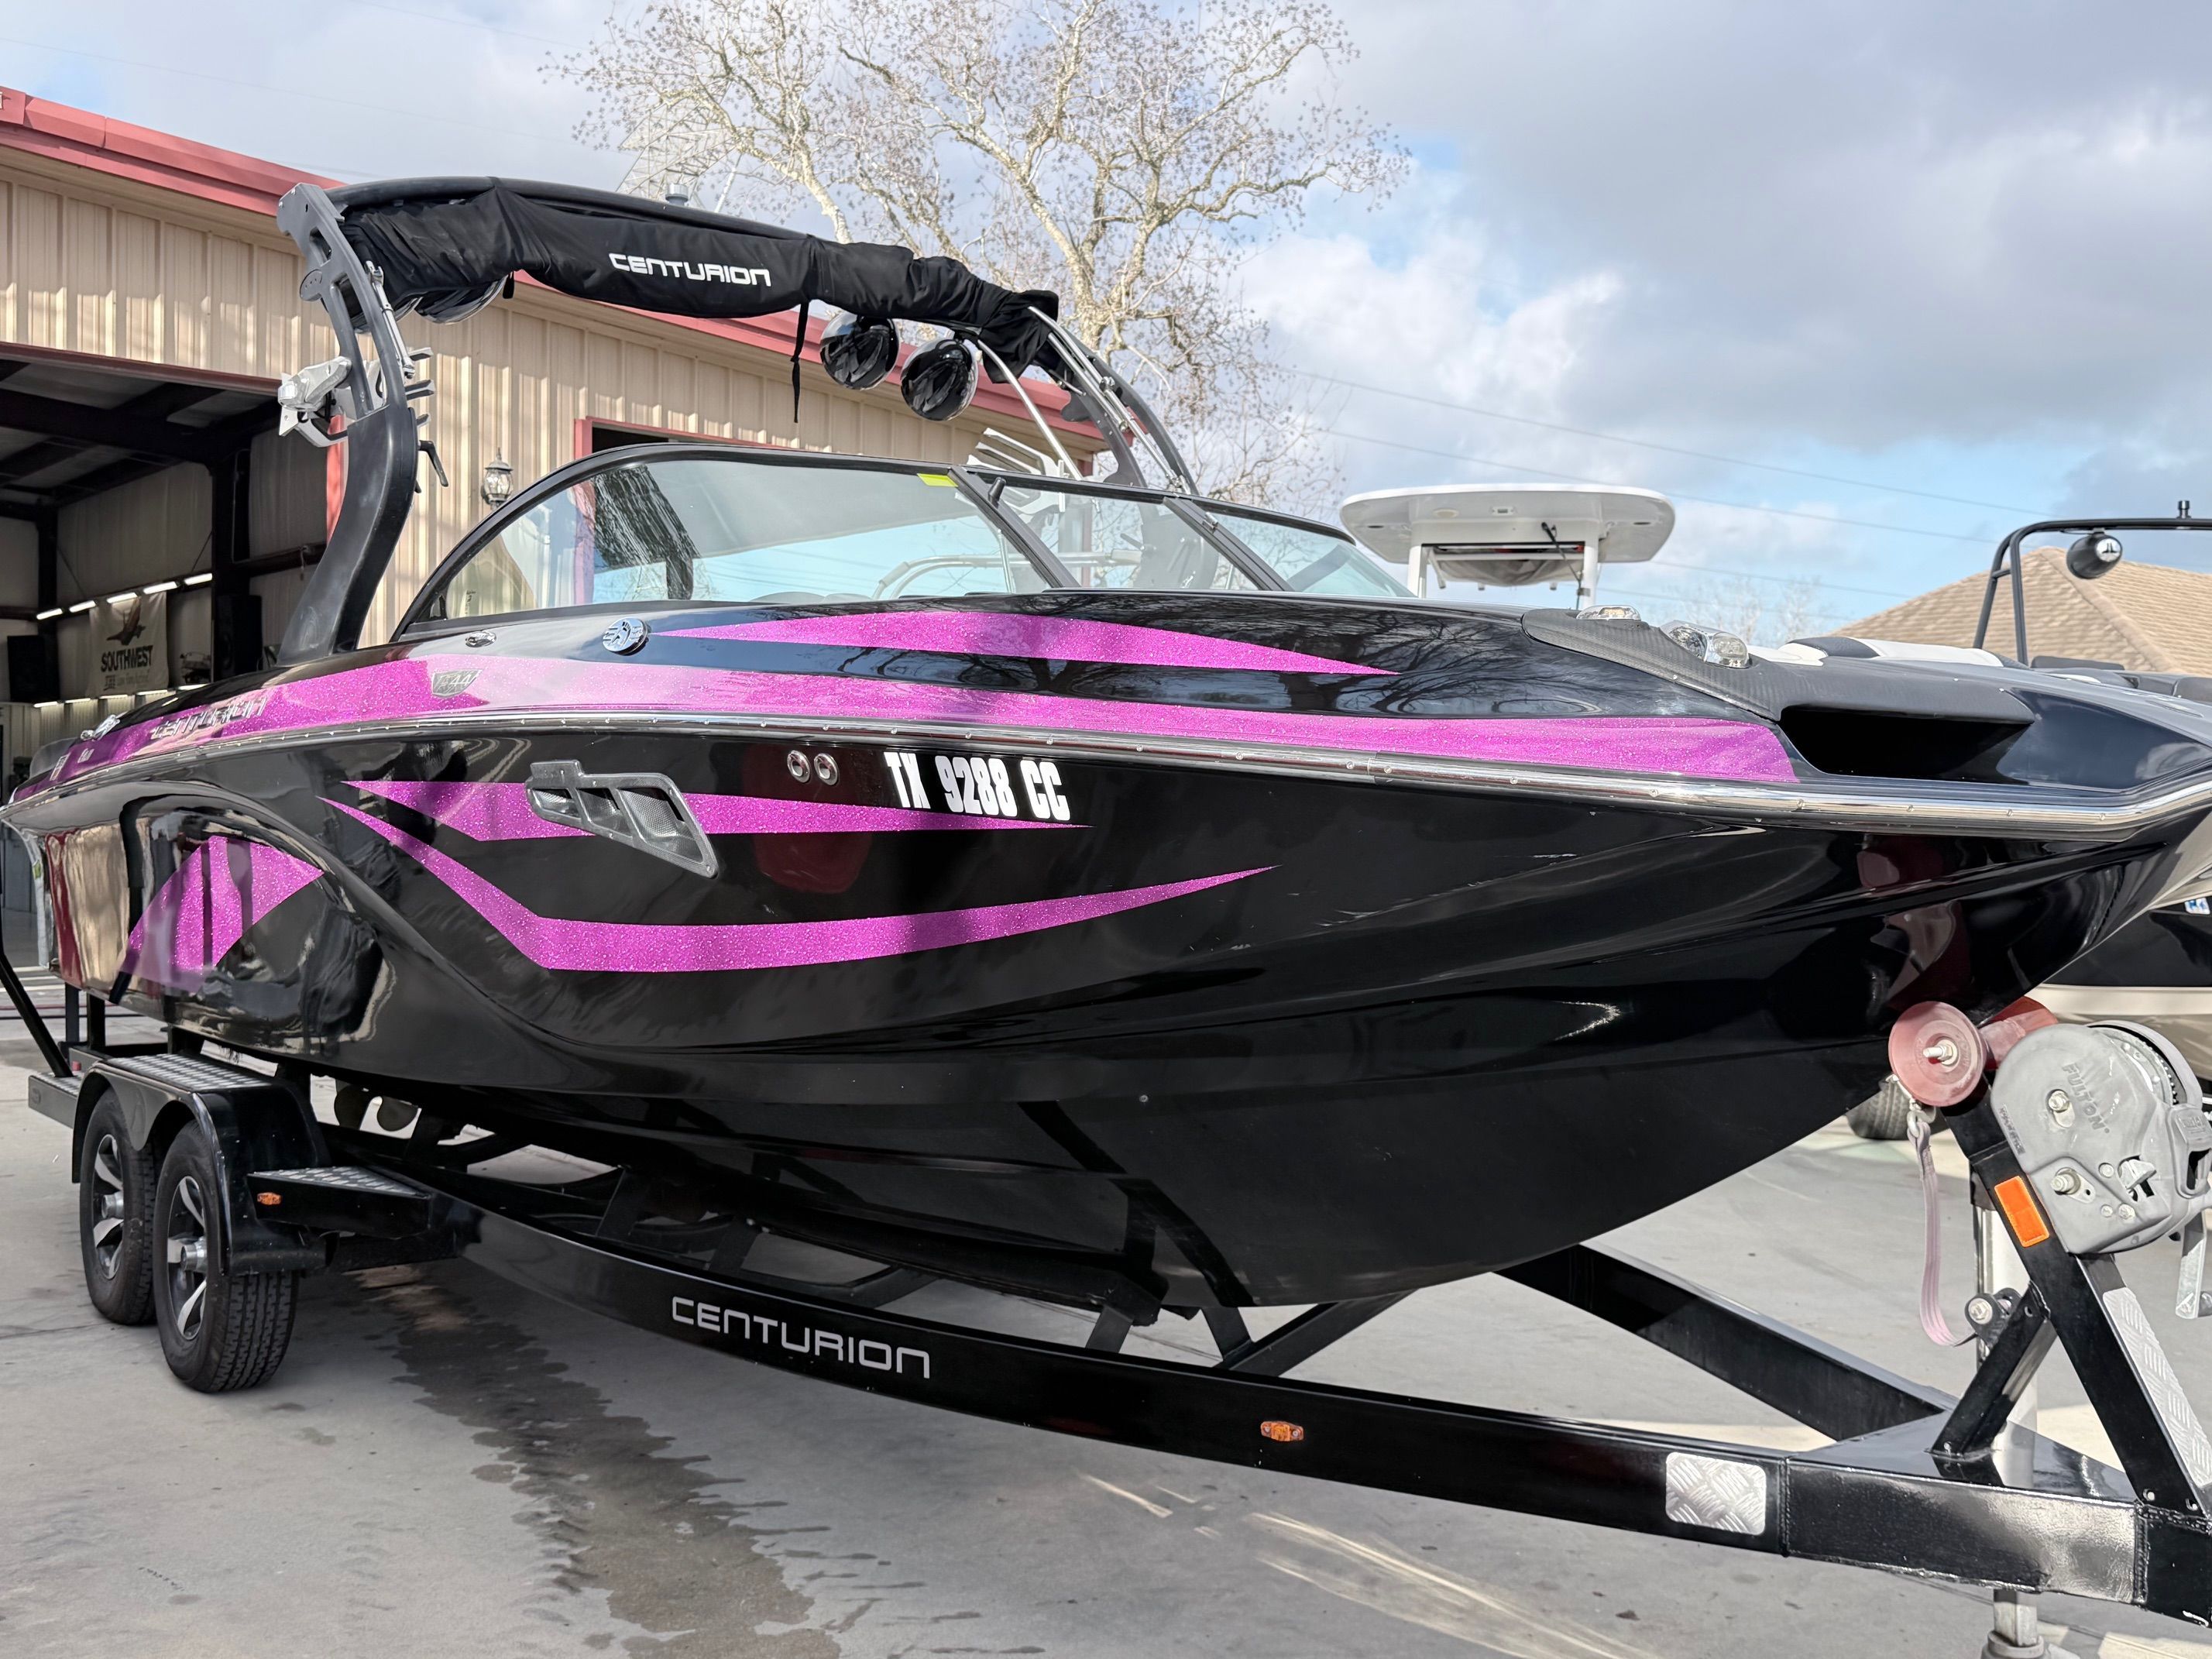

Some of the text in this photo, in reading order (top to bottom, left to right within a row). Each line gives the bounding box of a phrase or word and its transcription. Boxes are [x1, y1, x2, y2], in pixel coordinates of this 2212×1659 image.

[609, 253, 771, 287] CENTURION
[101, 645, 153, 672] SOUTHWEST
[884, 752, 1070, 821] TX 9288 CC
[2062, 1063, 2105, 1130] FULTON
[672, 1297, 929, 1379] CENTURION
